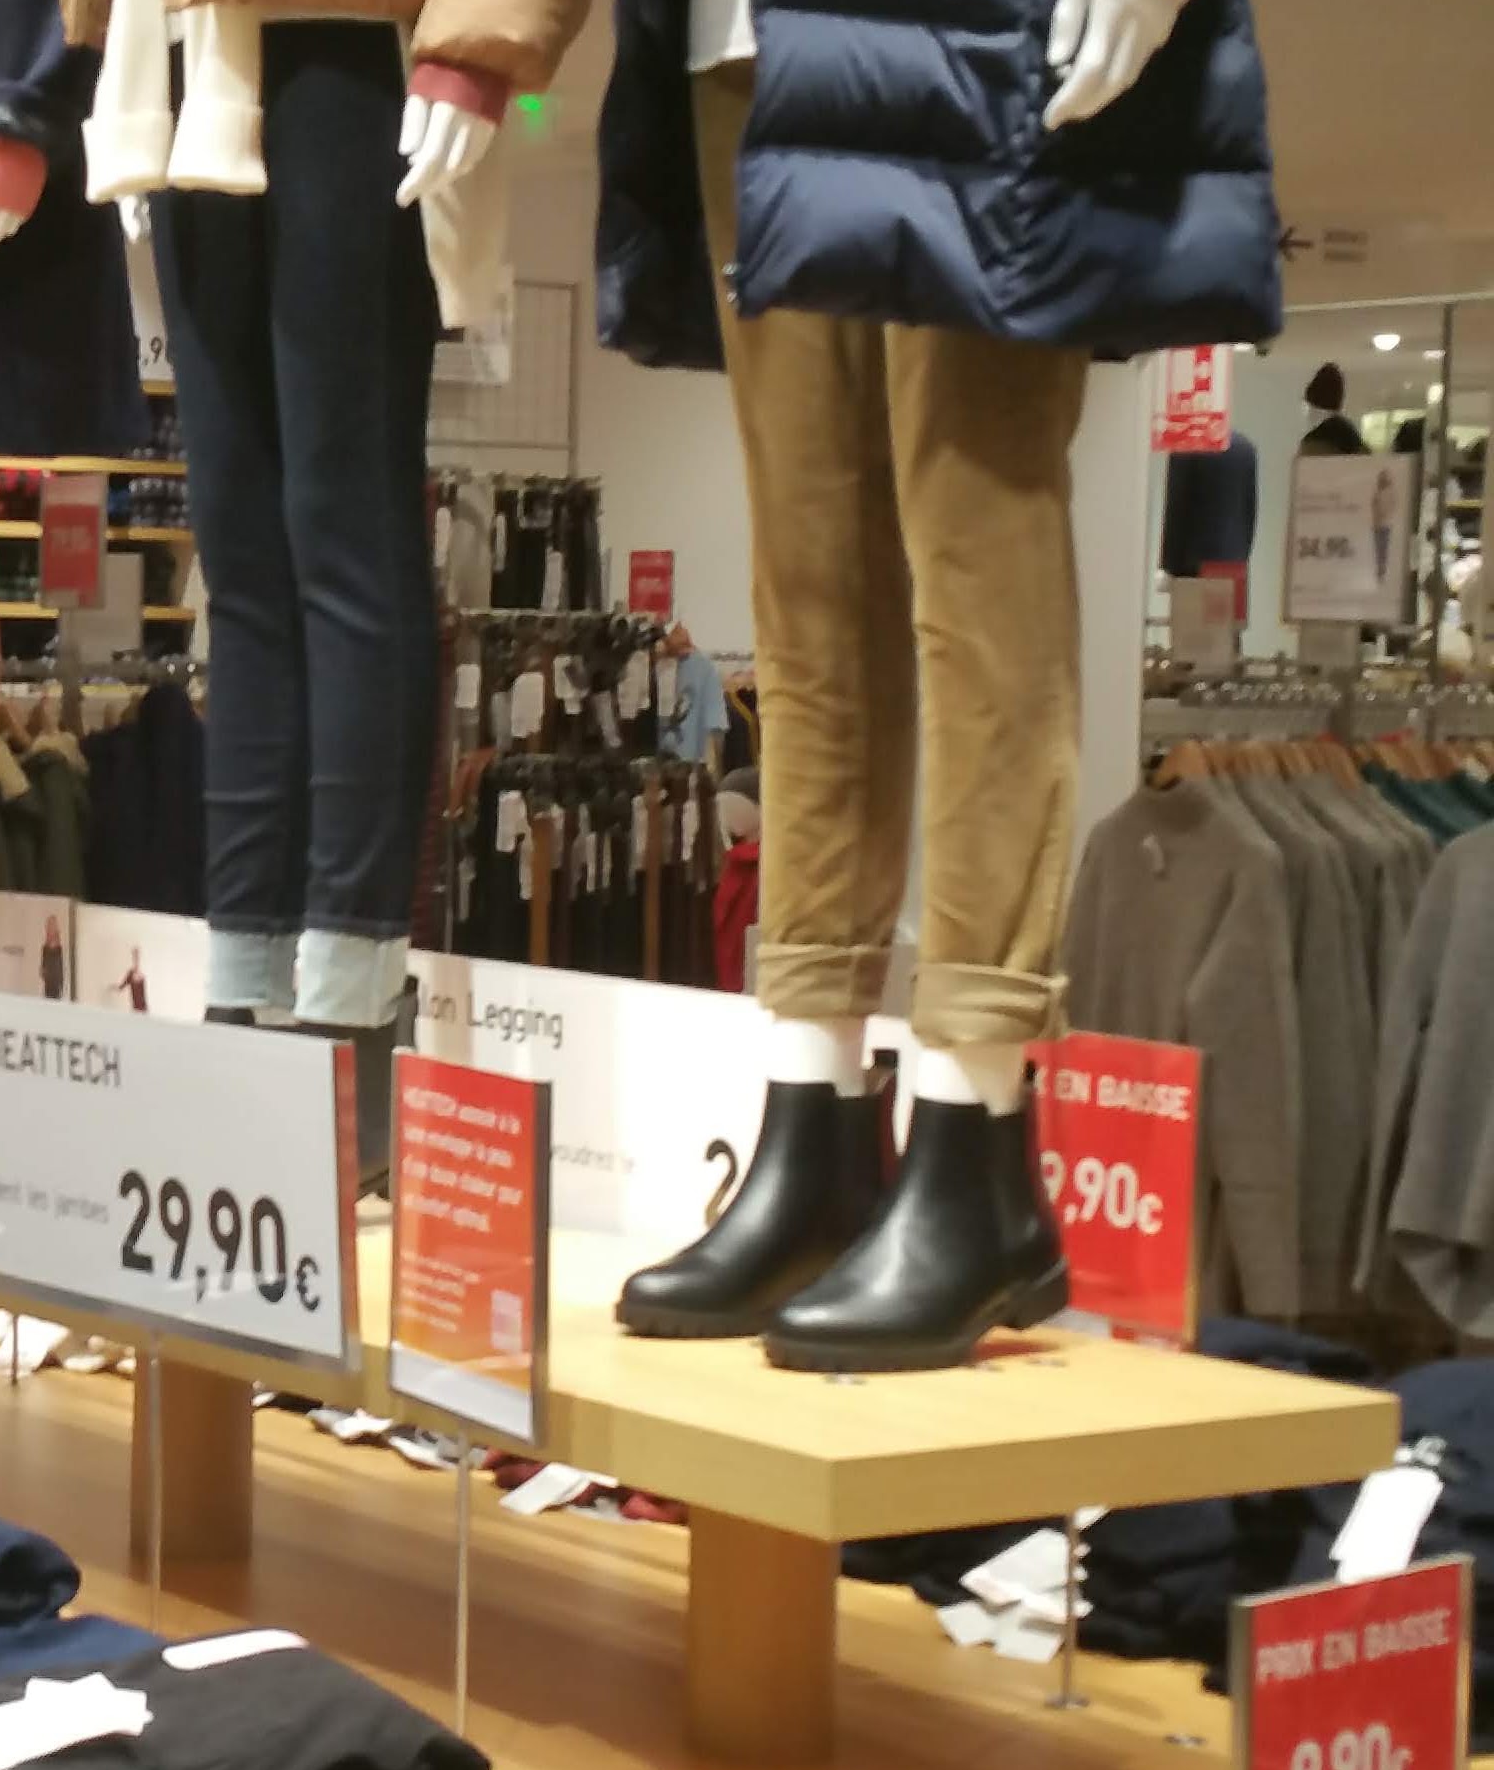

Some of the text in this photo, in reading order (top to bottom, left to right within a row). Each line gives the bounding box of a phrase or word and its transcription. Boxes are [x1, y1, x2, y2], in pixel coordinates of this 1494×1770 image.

[467, 992, 563, 1050] Legging
[1098, 1075, 1191, 1122] BAISSE
[119, 1168, 321, 1312] 29,90€
